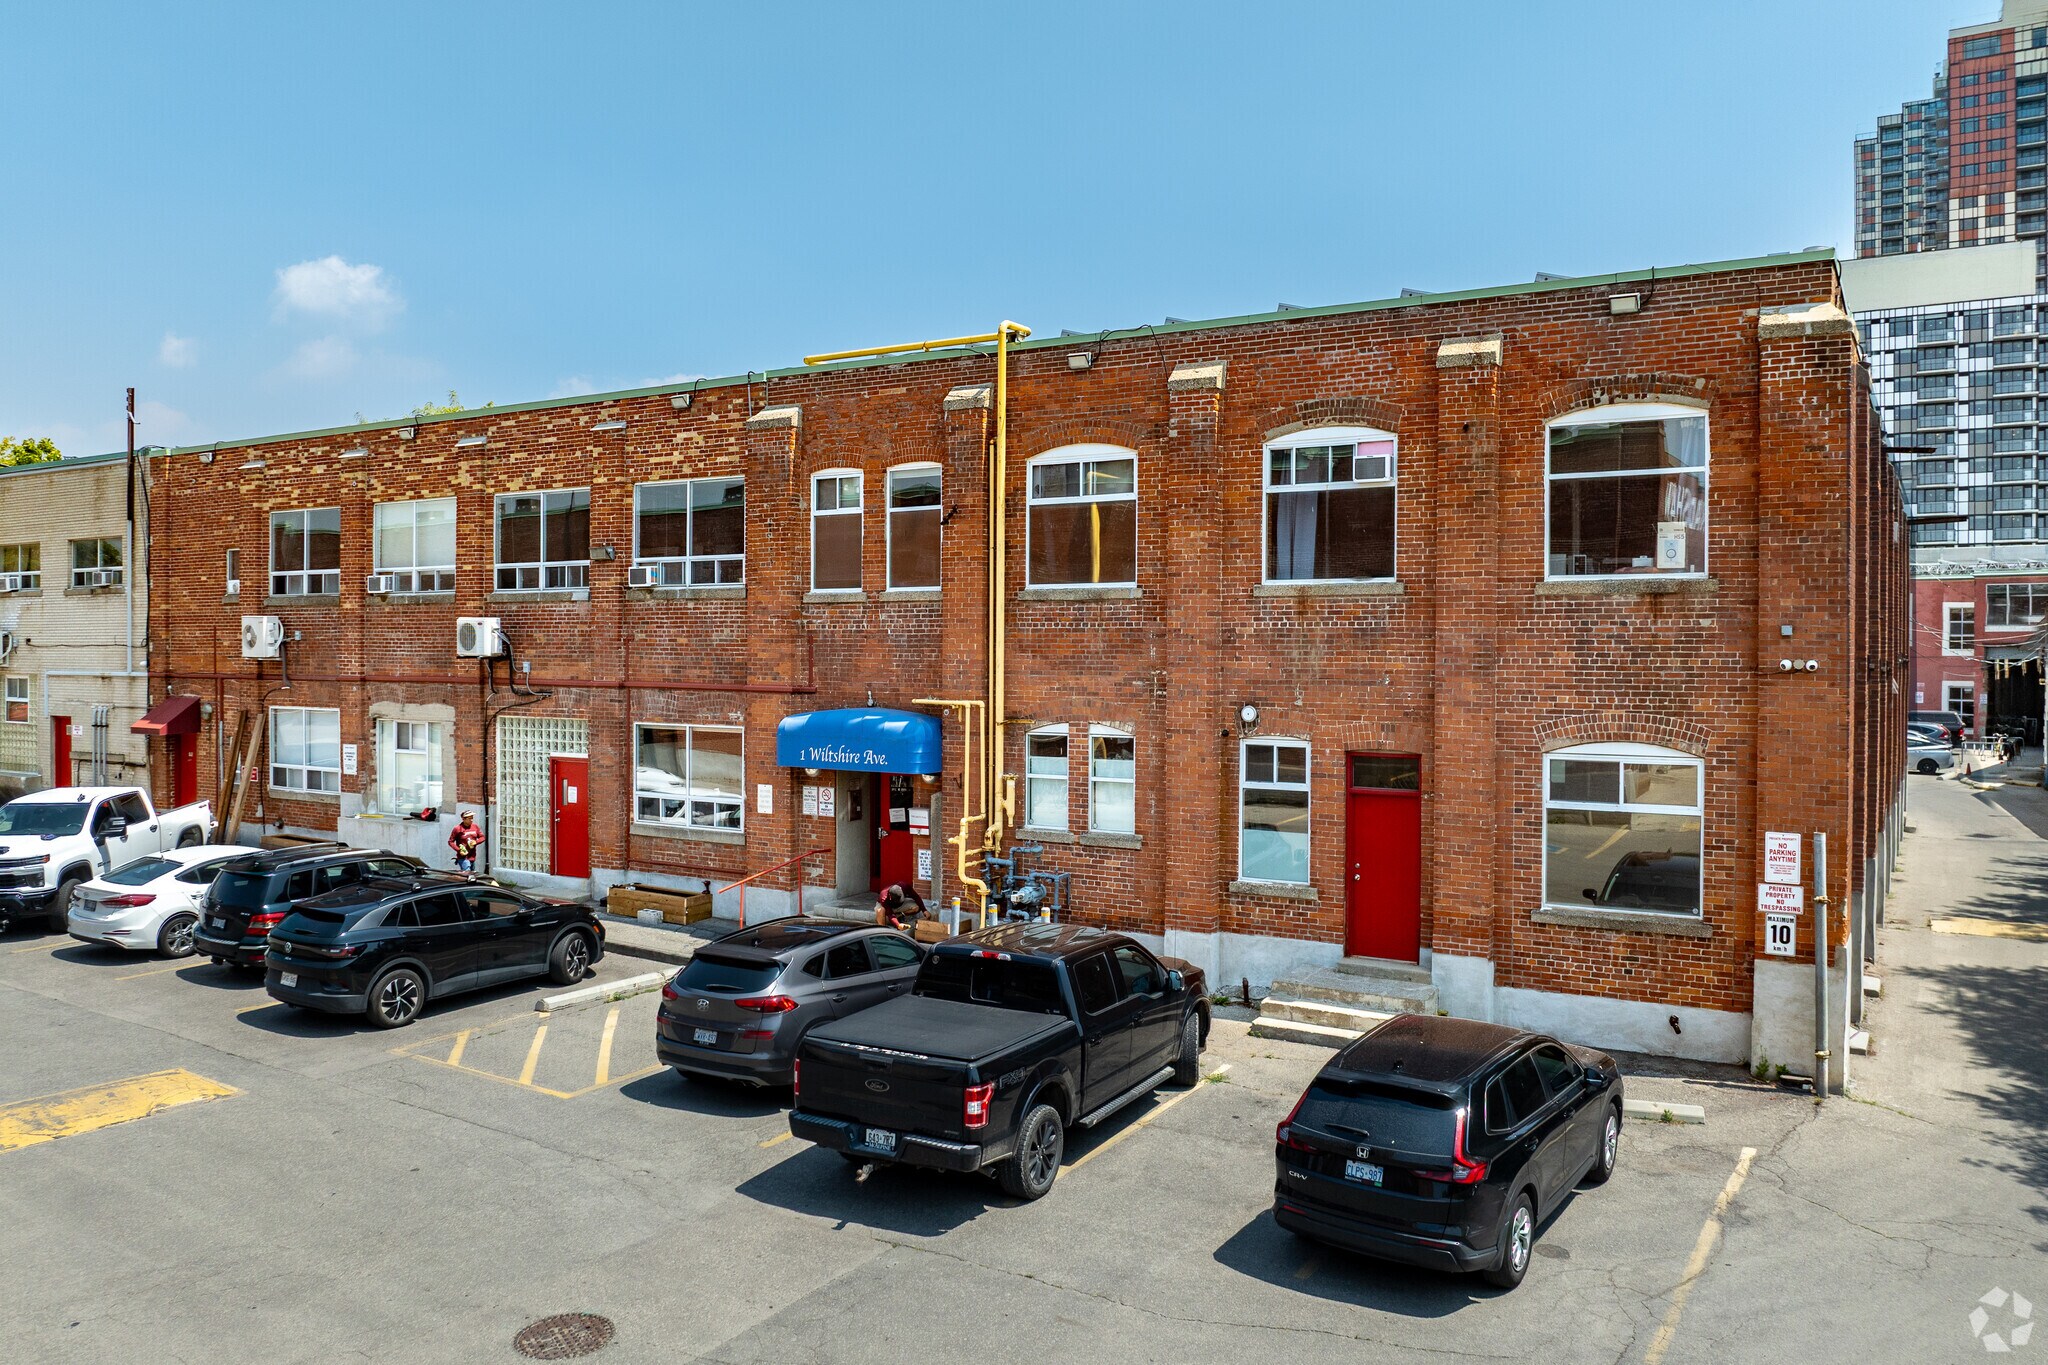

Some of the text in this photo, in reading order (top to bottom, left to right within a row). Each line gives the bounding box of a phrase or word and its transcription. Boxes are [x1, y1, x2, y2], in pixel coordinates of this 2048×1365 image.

[800, 744, 888, 765] 1 Wiltshire Ave.
[1761, 904, 1801, 912] TRESPASSING
[1771, 925, 1791, 944] 10
